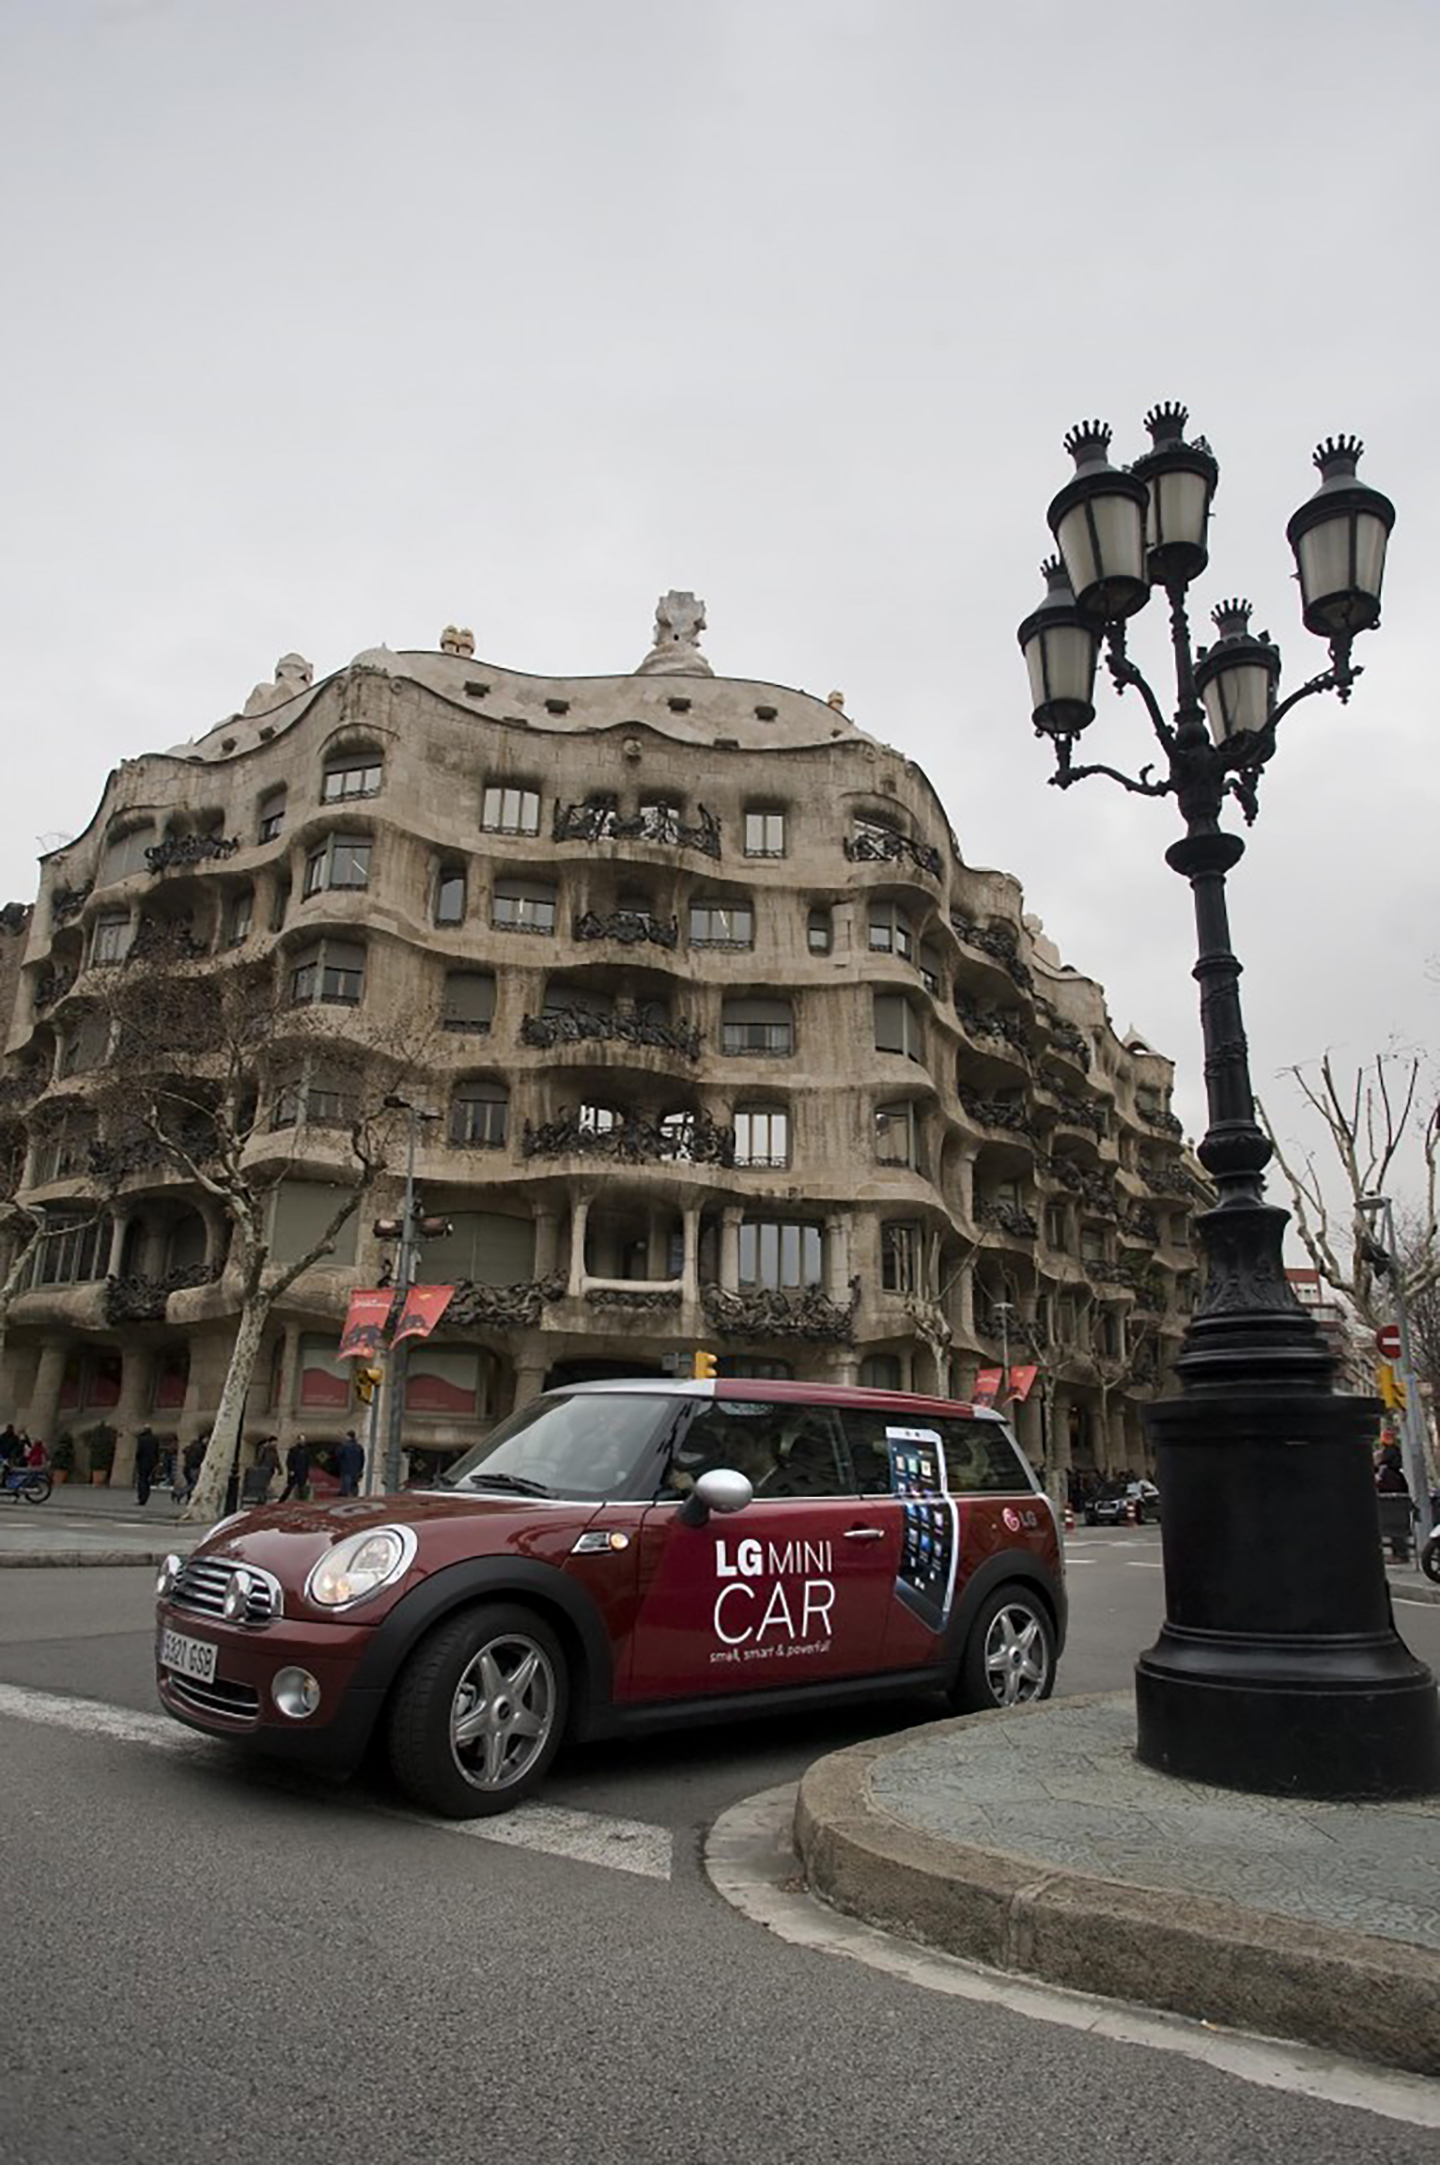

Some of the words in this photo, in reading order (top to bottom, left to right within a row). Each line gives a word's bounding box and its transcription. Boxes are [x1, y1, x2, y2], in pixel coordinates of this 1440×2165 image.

[1018, 1510, 1037, 1527] LG
[716, 1539, 763, 1577] LG
[769, 1540, 832, 1574] MINI
[714, 1580, 835, 1644] CAR
